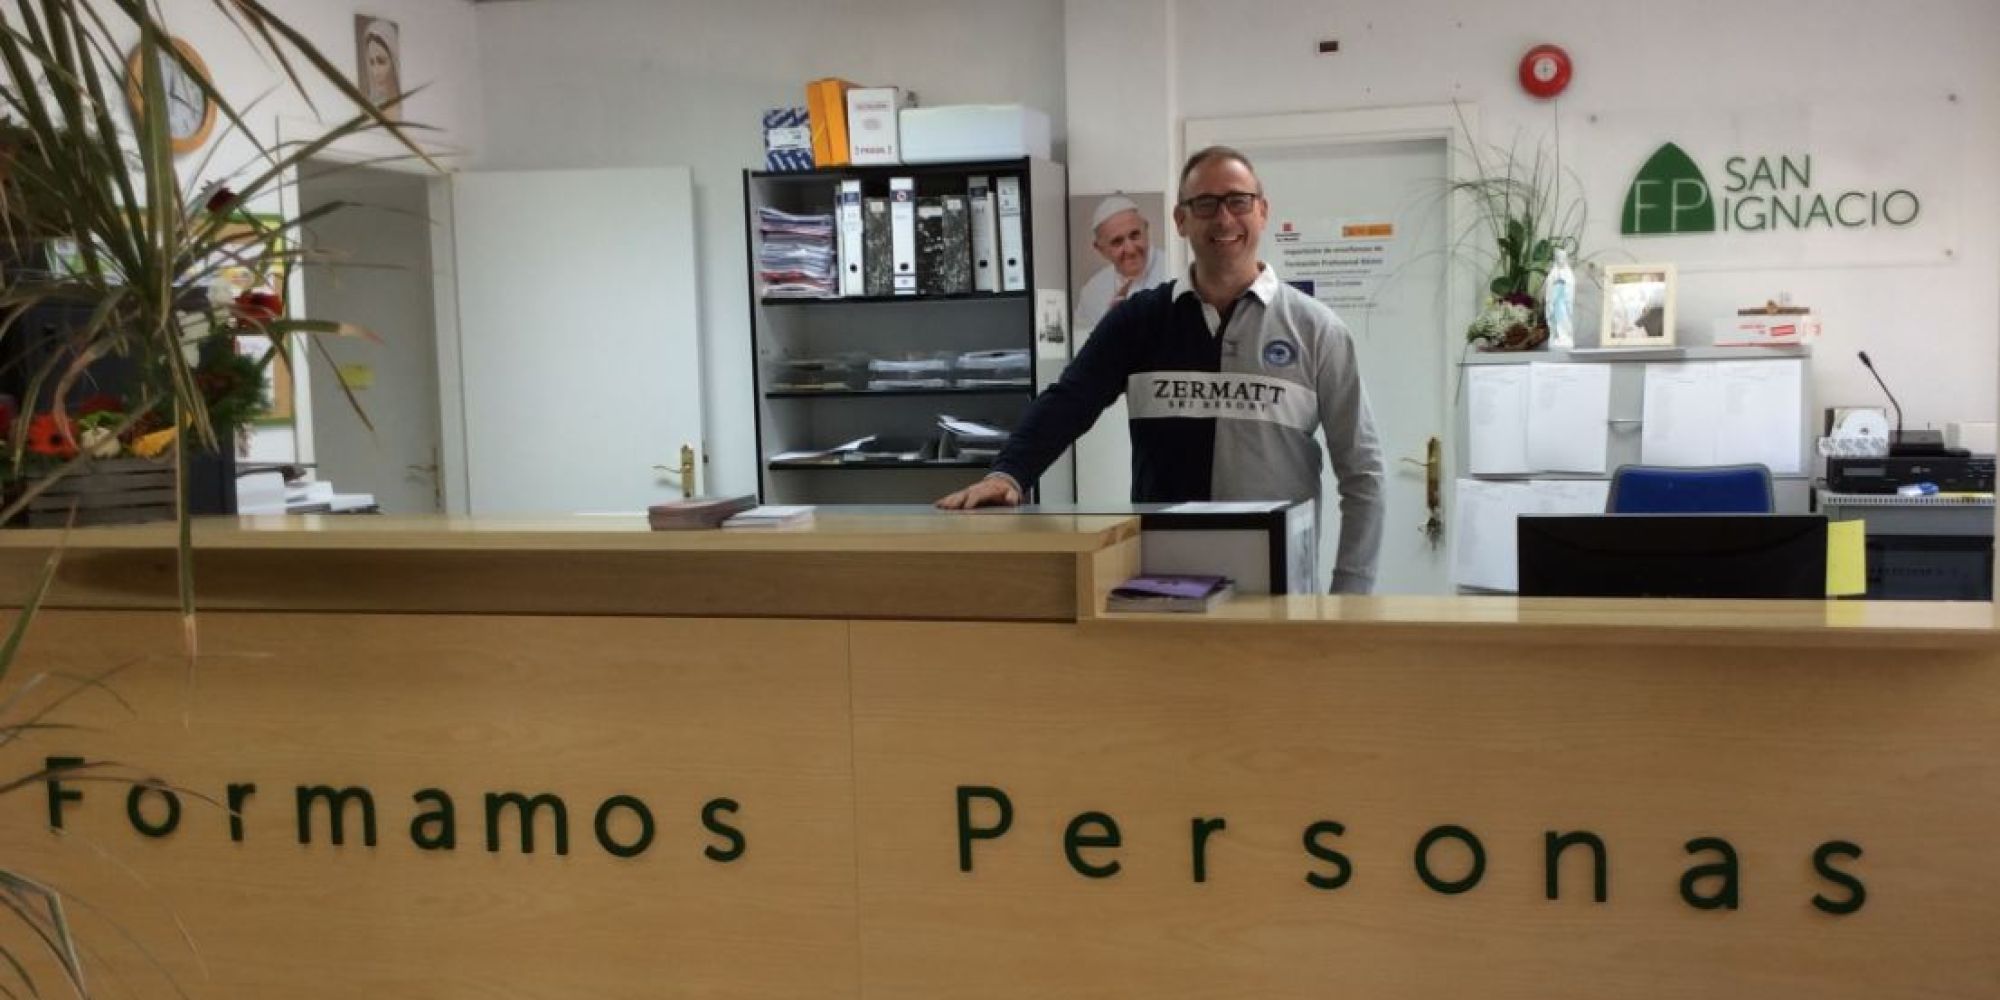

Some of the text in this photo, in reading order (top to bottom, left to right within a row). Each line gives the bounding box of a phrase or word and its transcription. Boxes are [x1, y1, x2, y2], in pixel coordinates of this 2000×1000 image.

[1724, 154, 1811, 192] SAN
[1634, 177, 1708, 233] FP
[1724, 189, 1920, 233] IGNACIO
[1153, 380, 1287, 404] ZERMATT
[1168, 400, 1267, 412] SKI RESORT
[46, 756, 1867, 916] Formamos Personas
